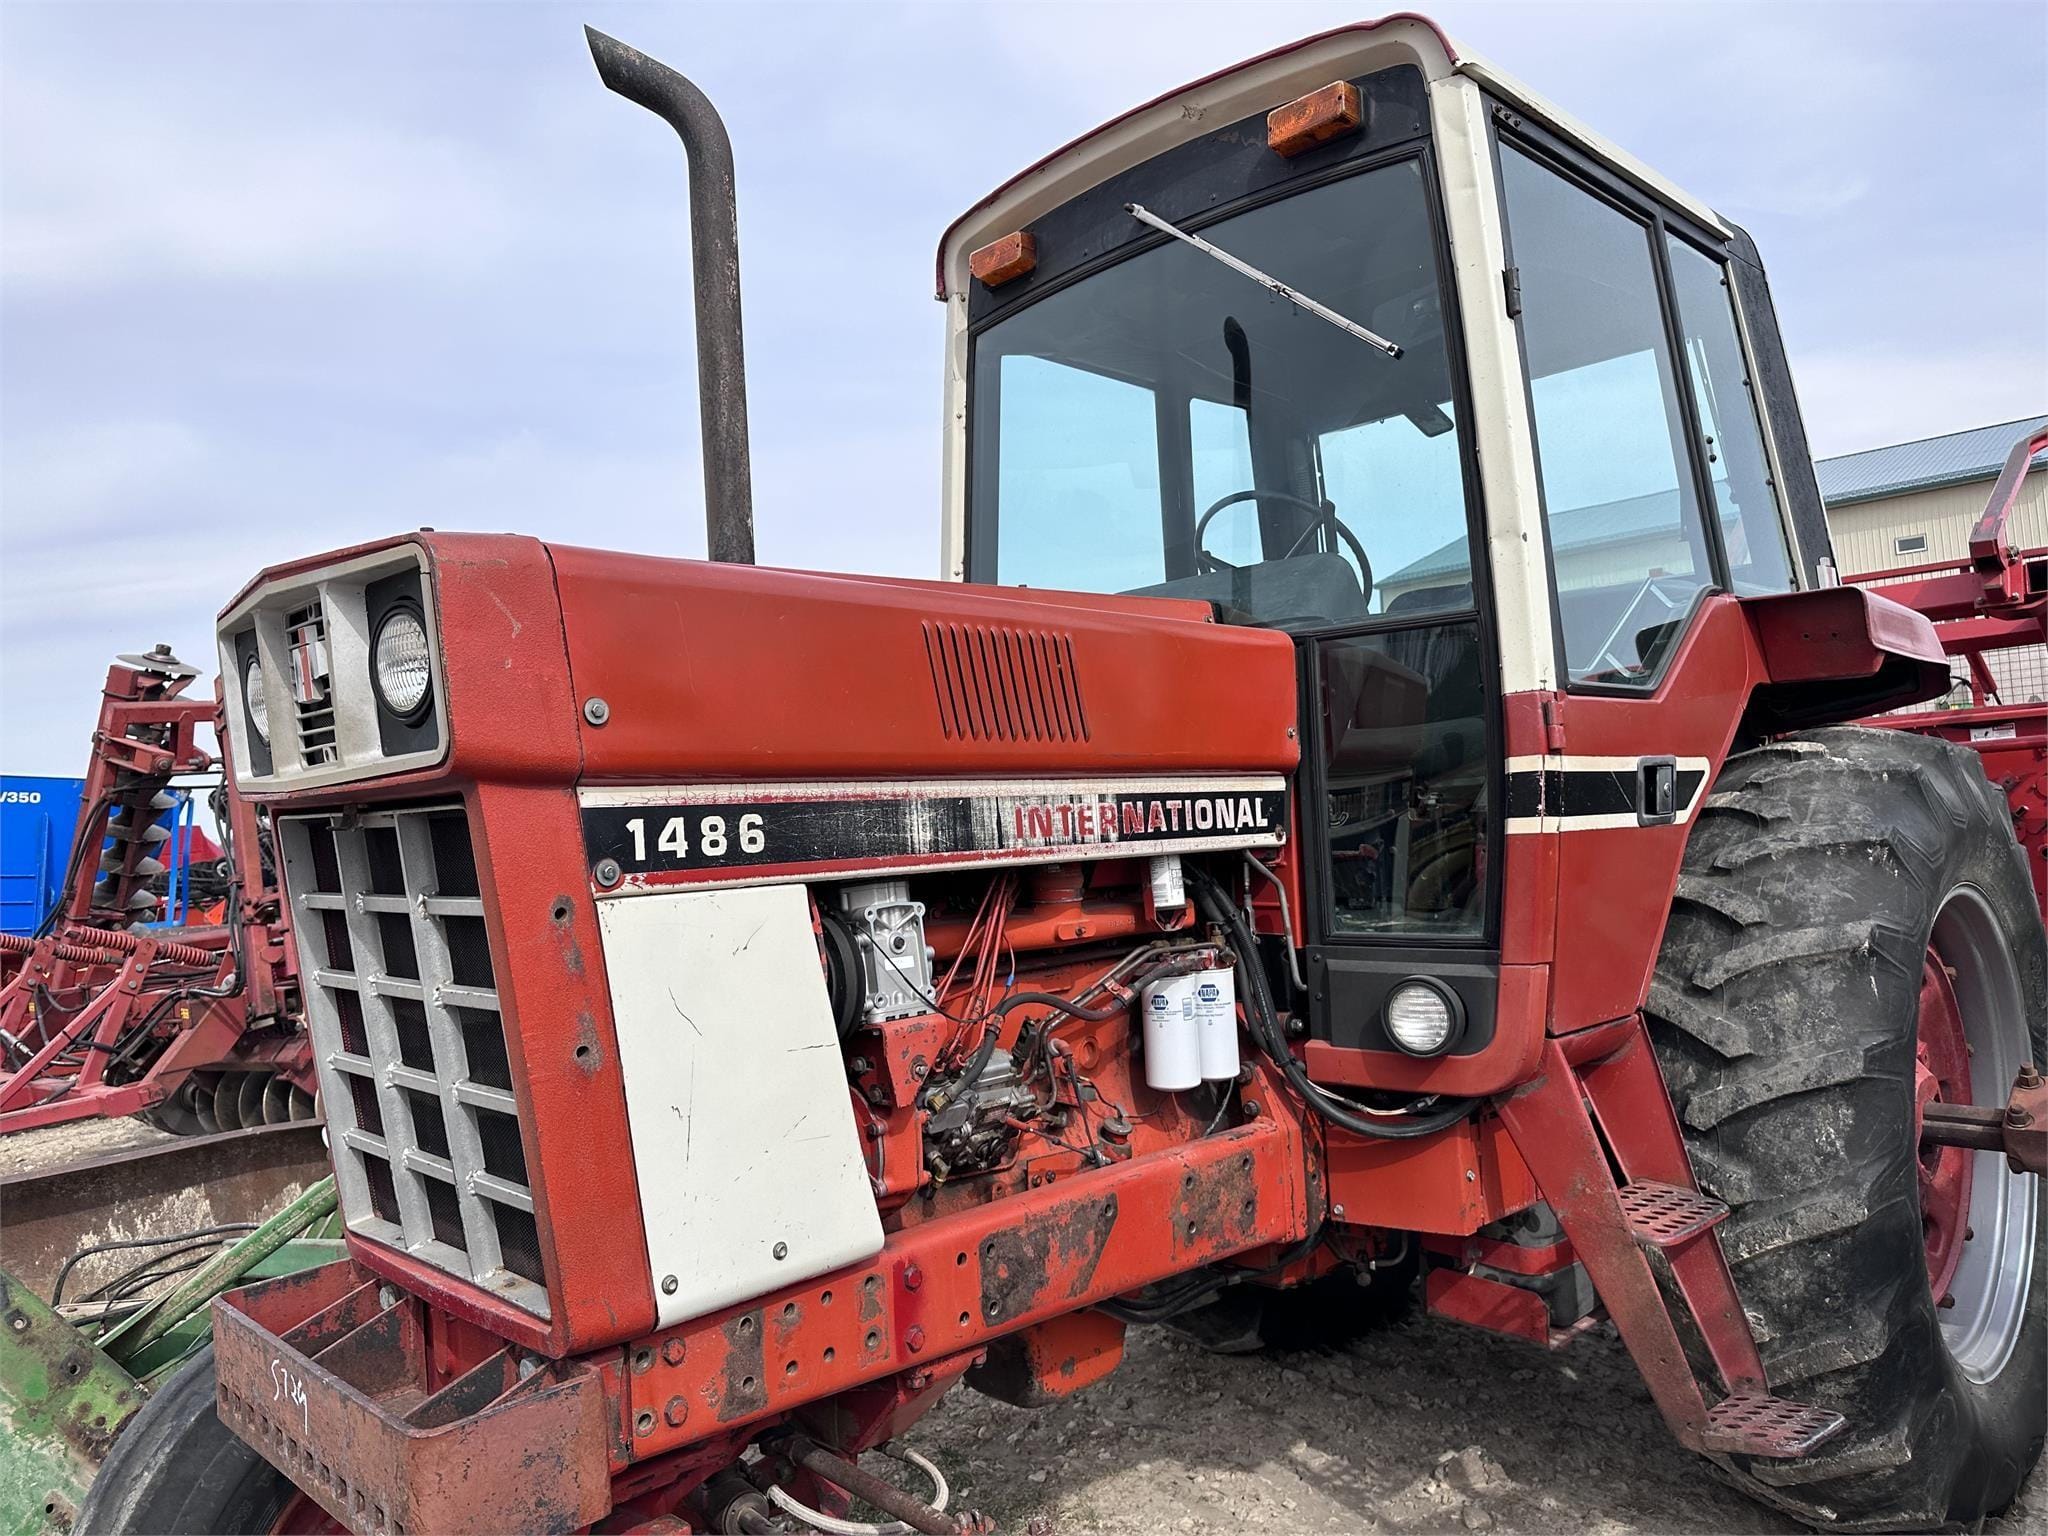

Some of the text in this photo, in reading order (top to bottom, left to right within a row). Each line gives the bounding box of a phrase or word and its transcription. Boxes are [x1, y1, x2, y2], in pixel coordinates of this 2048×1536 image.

[625, 813, 765, 861] 1486
[1014, 797, 1269, 839] INTERNATIONAL
[1200, 987, 1217, 998] NAPA
